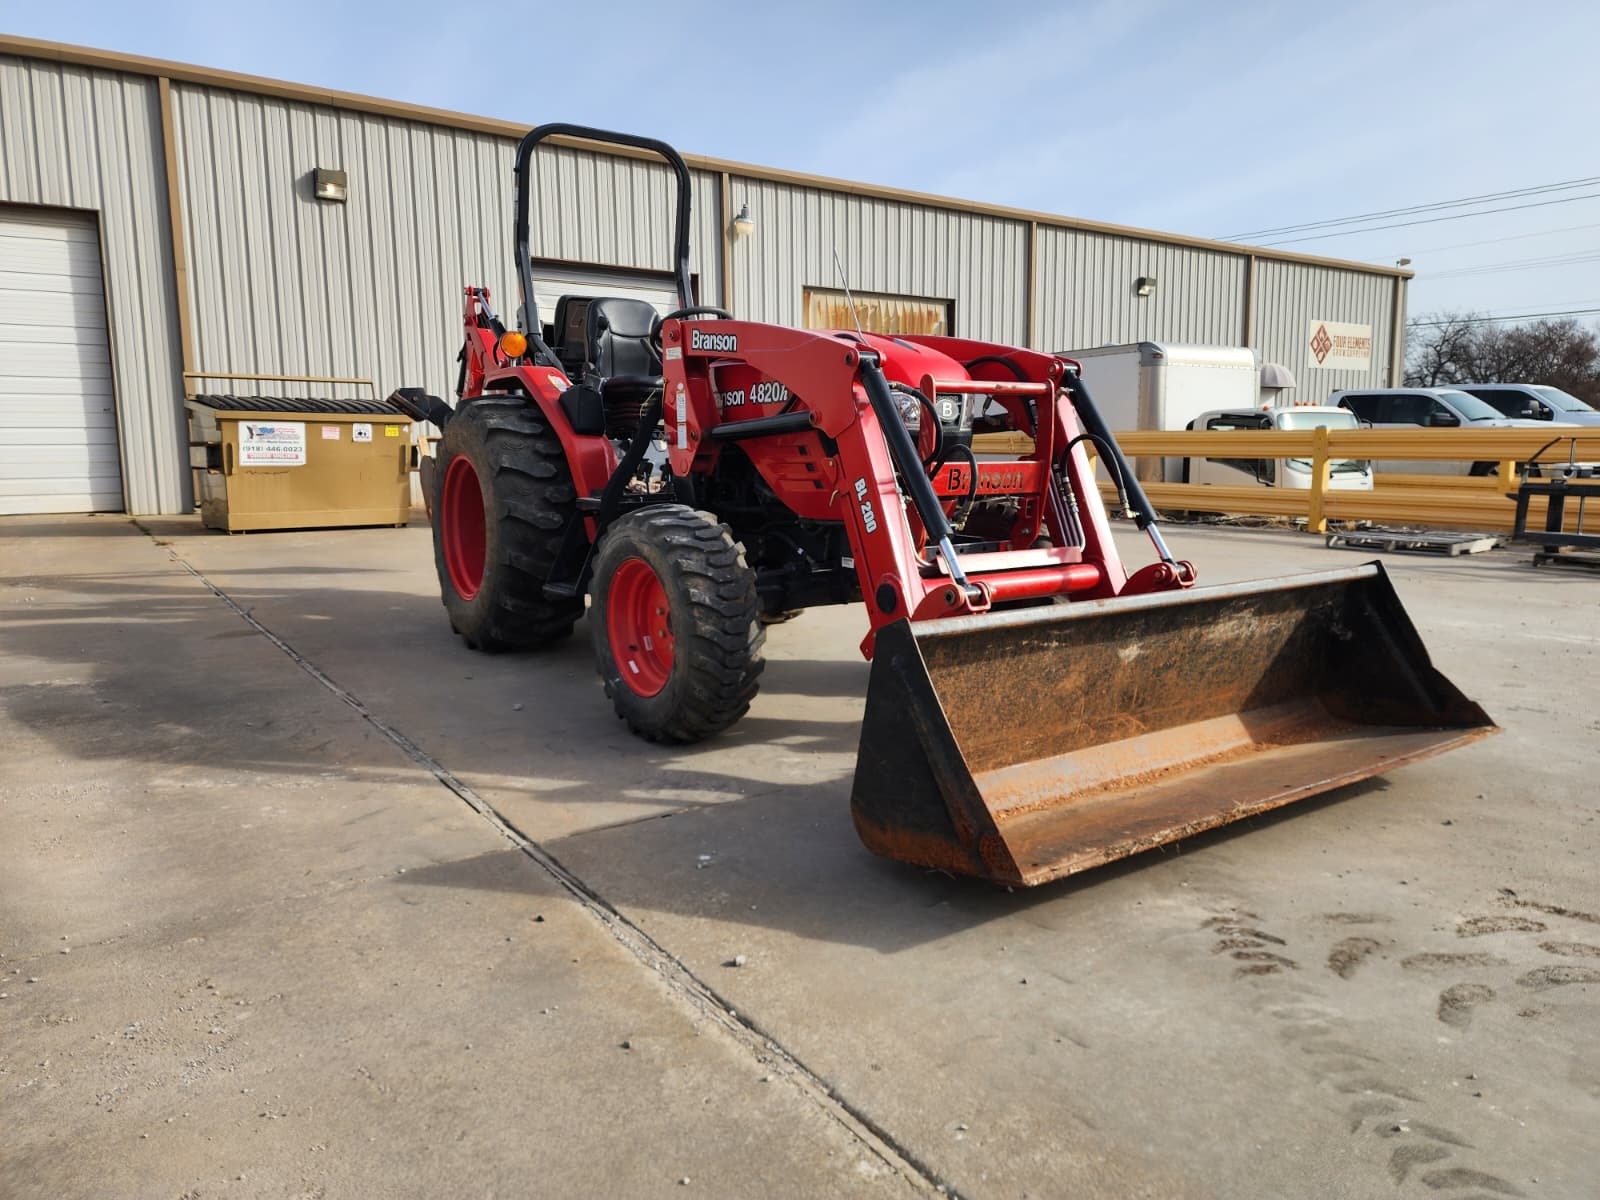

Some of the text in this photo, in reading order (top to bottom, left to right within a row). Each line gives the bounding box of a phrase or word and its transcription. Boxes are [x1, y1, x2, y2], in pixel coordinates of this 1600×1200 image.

[692, 328, 737, 351] Branson
[942, 401, 953, 416] B
[948, 468, 1023, 491] Brnson
[854, 477, 878, 534] BL 200
